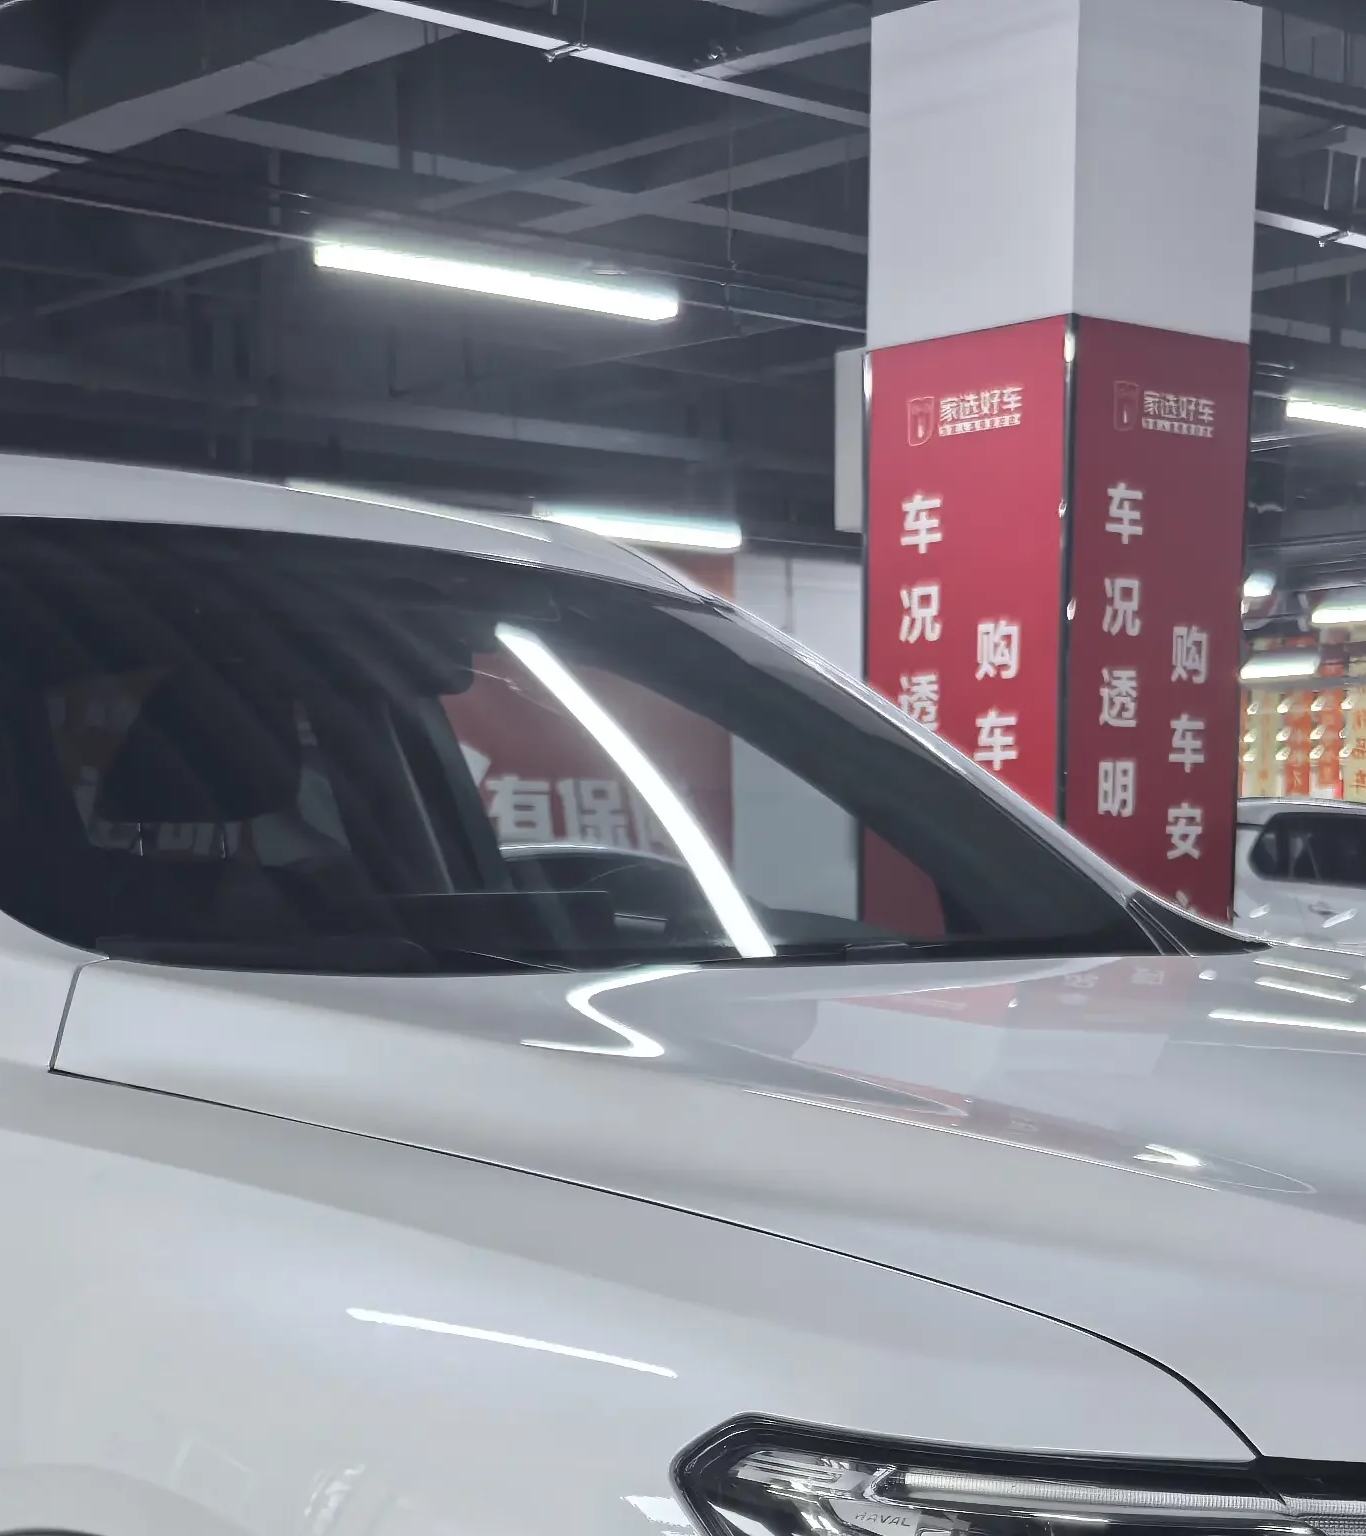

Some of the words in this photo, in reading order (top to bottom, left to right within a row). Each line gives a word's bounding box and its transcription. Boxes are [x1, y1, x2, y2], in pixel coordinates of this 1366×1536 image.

[939, 387, 1023, 421] 家选好车
[974, 619, 1021, 770] 购车
[1098, 482, 1144, 818] 车况透明
[486, 774, 683, 853] 有保
[1165, 625, 1209, 911] 购车安
[855, 1511, 911, 1527] HAVAL
